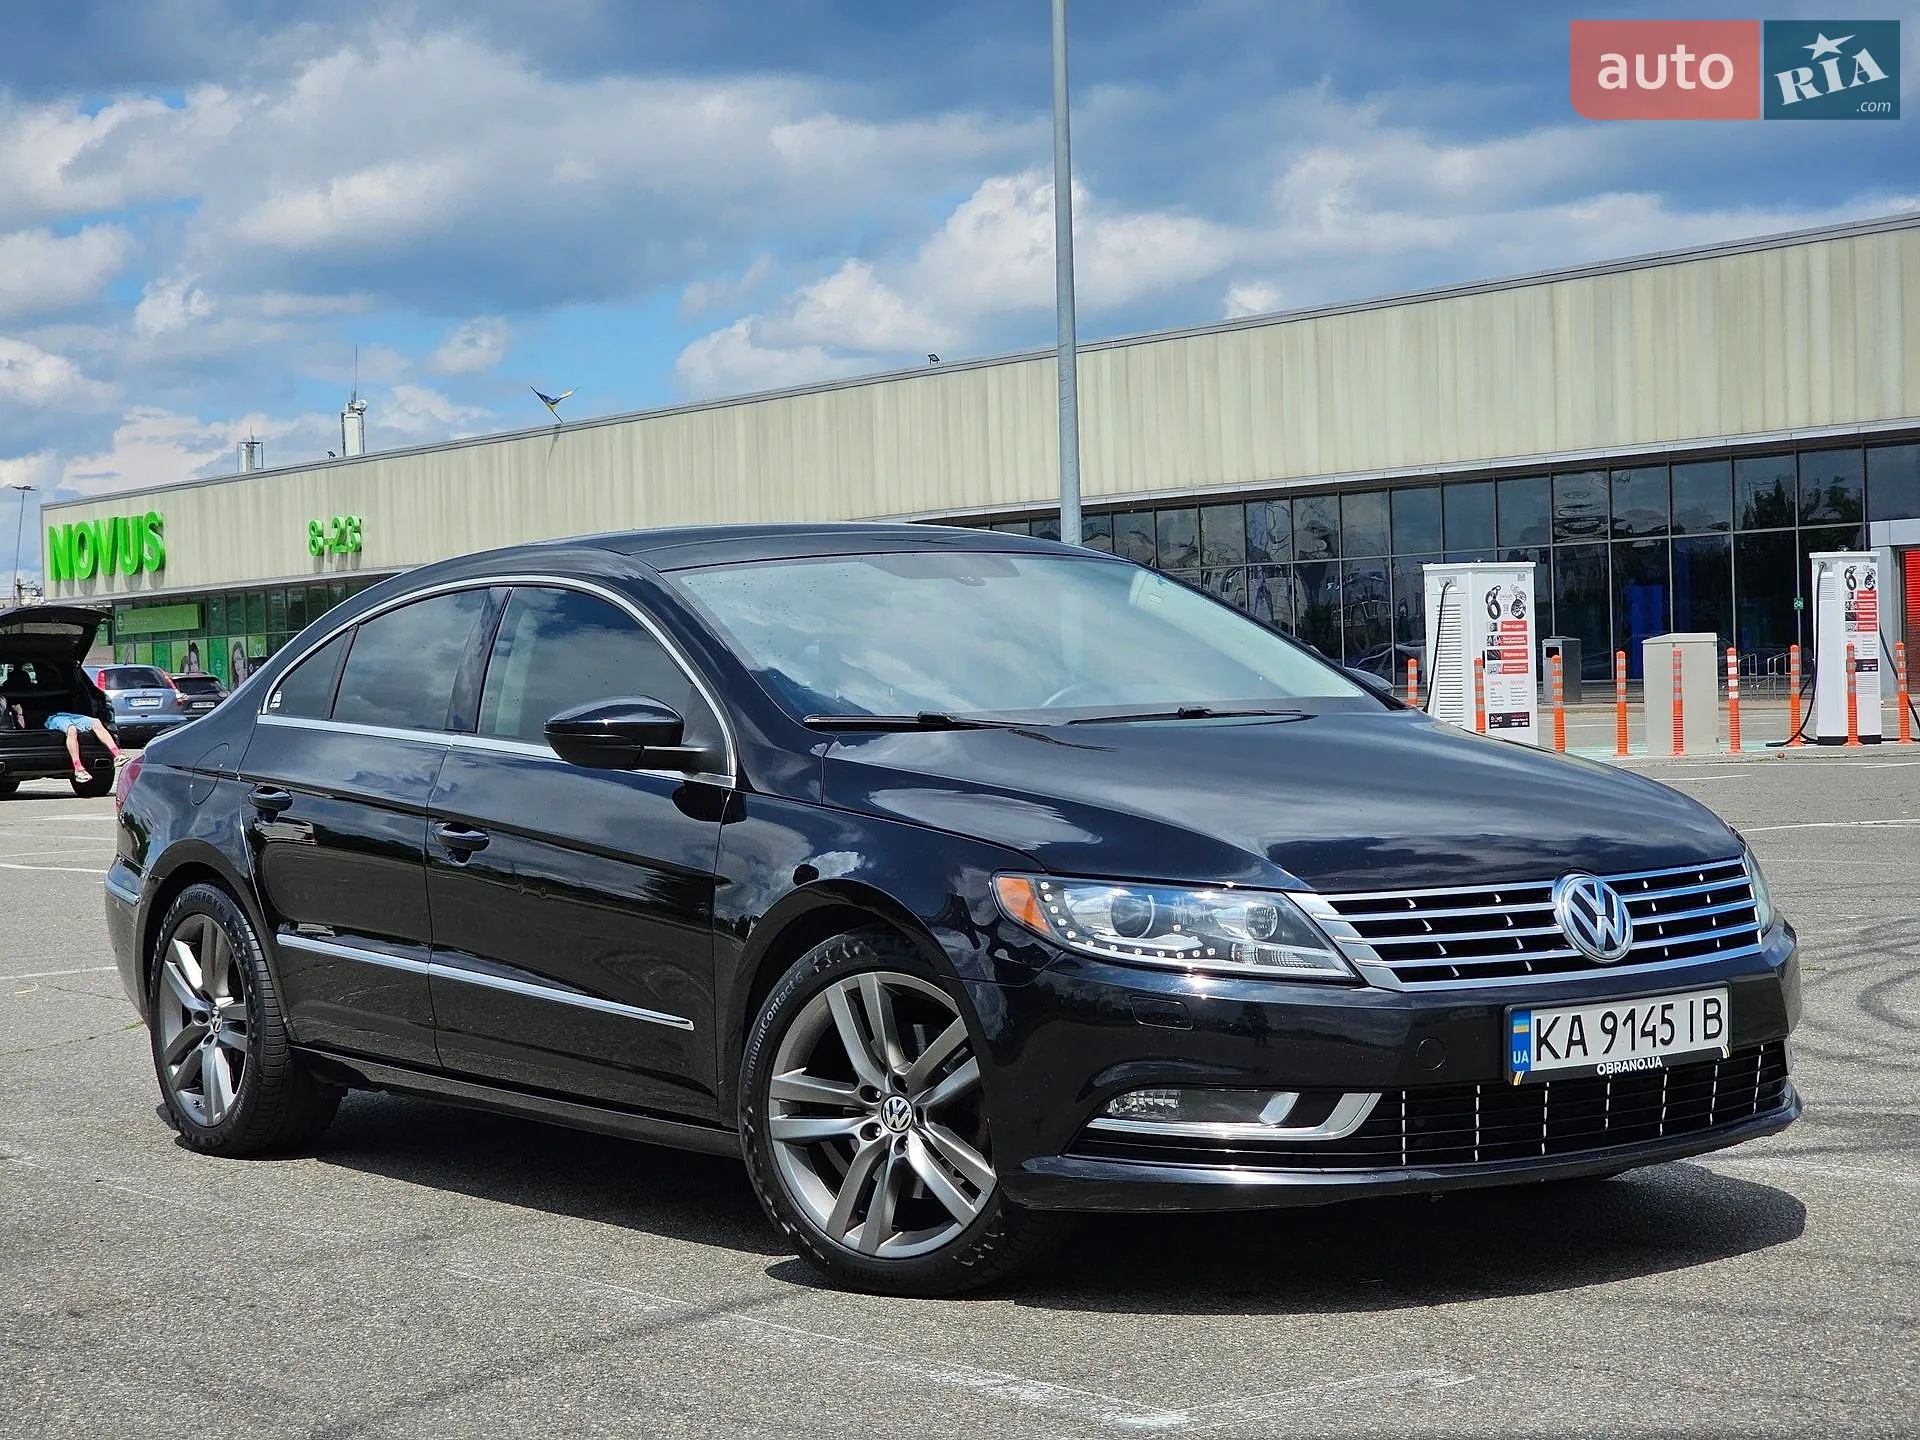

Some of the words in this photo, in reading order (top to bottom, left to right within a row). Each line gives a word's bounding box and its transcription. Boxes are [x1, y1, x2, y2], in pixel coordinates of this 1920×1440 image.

[48, 511, 166, 582] NOVUS
[308, 516, 362, 556] 8-23
[1535, 1014, 1590, 1062] KA
[1600, 1003, 1675, 1055] 9145
[1689, 997, 1723, 1043] IB
[1512, 1049, 1530, 1065] UA
[1596, 1056, 1664, 1076] OBRANO.UA
